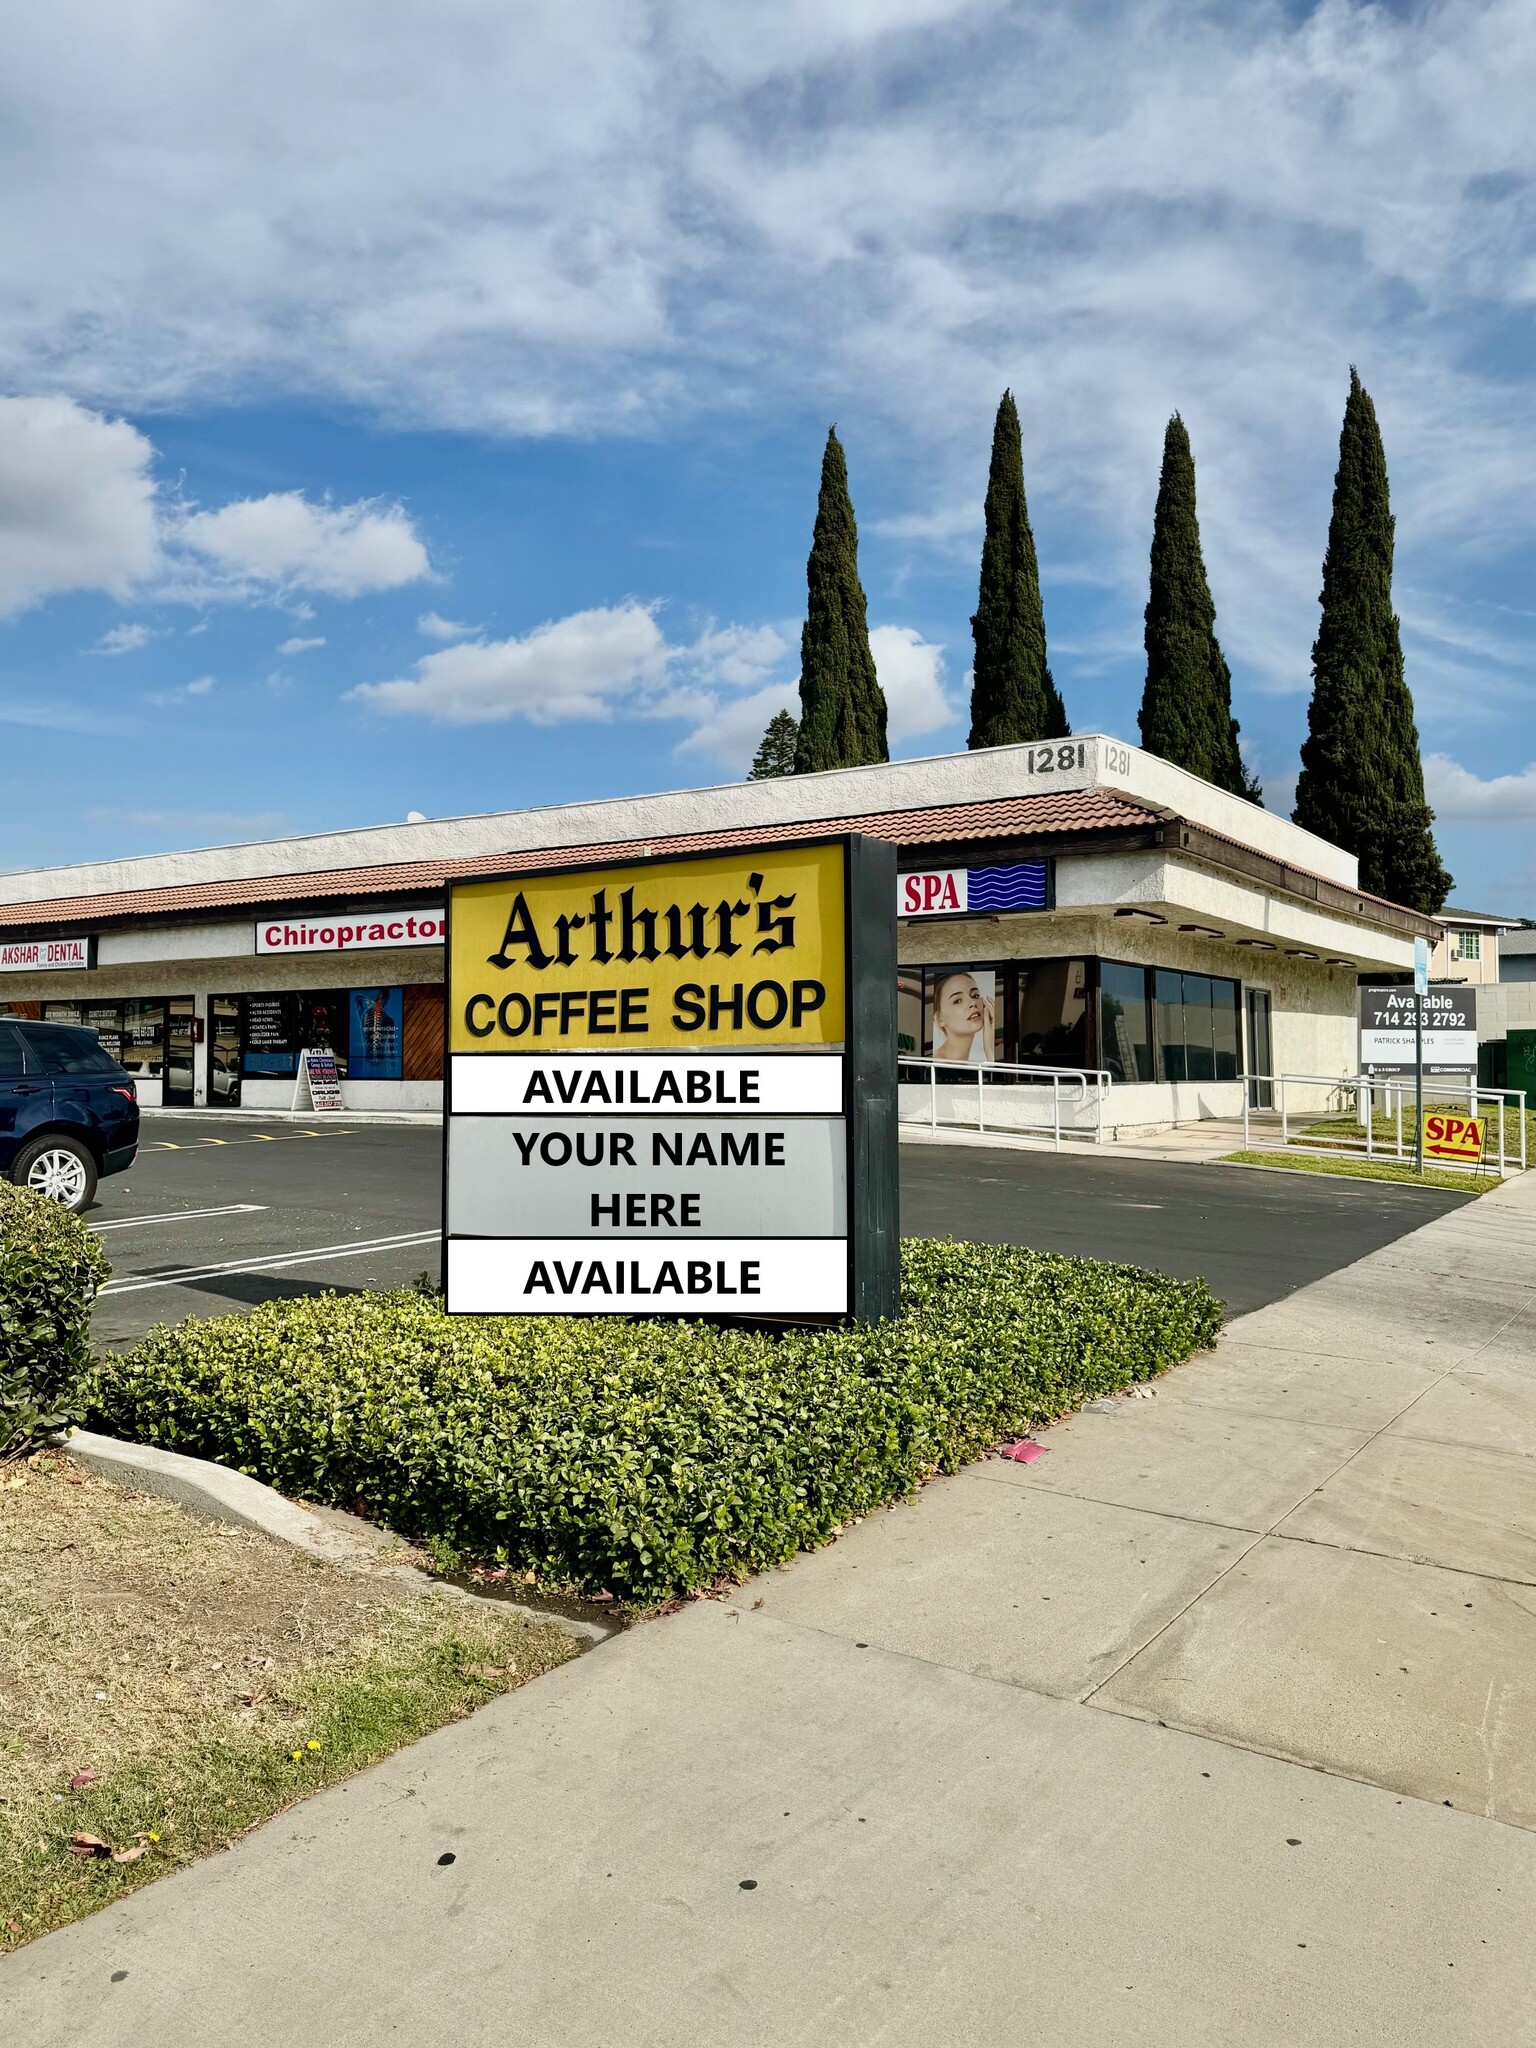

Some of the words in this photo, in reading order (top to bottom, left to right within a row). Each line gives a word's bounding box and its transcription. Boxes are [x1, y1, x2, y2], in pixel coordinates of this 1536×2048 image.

[1028, 743, 1085, 775] 1281
[1105, 744, 1131, 777] 1281
[904, 873, 961, 913] SPA
[486, 871, 798, 970] Arthur's
[1, 945, 39, 965] AKSHAR
[47, 943, 85, 962] DENTAL
[464, 987, 650, 1038] COFFEE
[672, 979, 827, 1032] SHOP
[1386, 994, 1454, 1009] Avaable
[1373, 1011, 1400, 1026] 714
[1432, 1012, 1466, 1027] 2792
[1373, 1037, 1401, 1045] PATRICK
[1402, 1037, 1435, 1045] SHAPLES
[522, 1070, 760, 1104] AVAILABLE
[1425, 1116, 1482, 1146] SPA
[511, 1131, 638, 1167] YOUR
[651, 1132, 786, 1166] NAME
[590, 1193, 702, 1227] HERE
[522, 1260, 761, 1295] AVAILABLE
